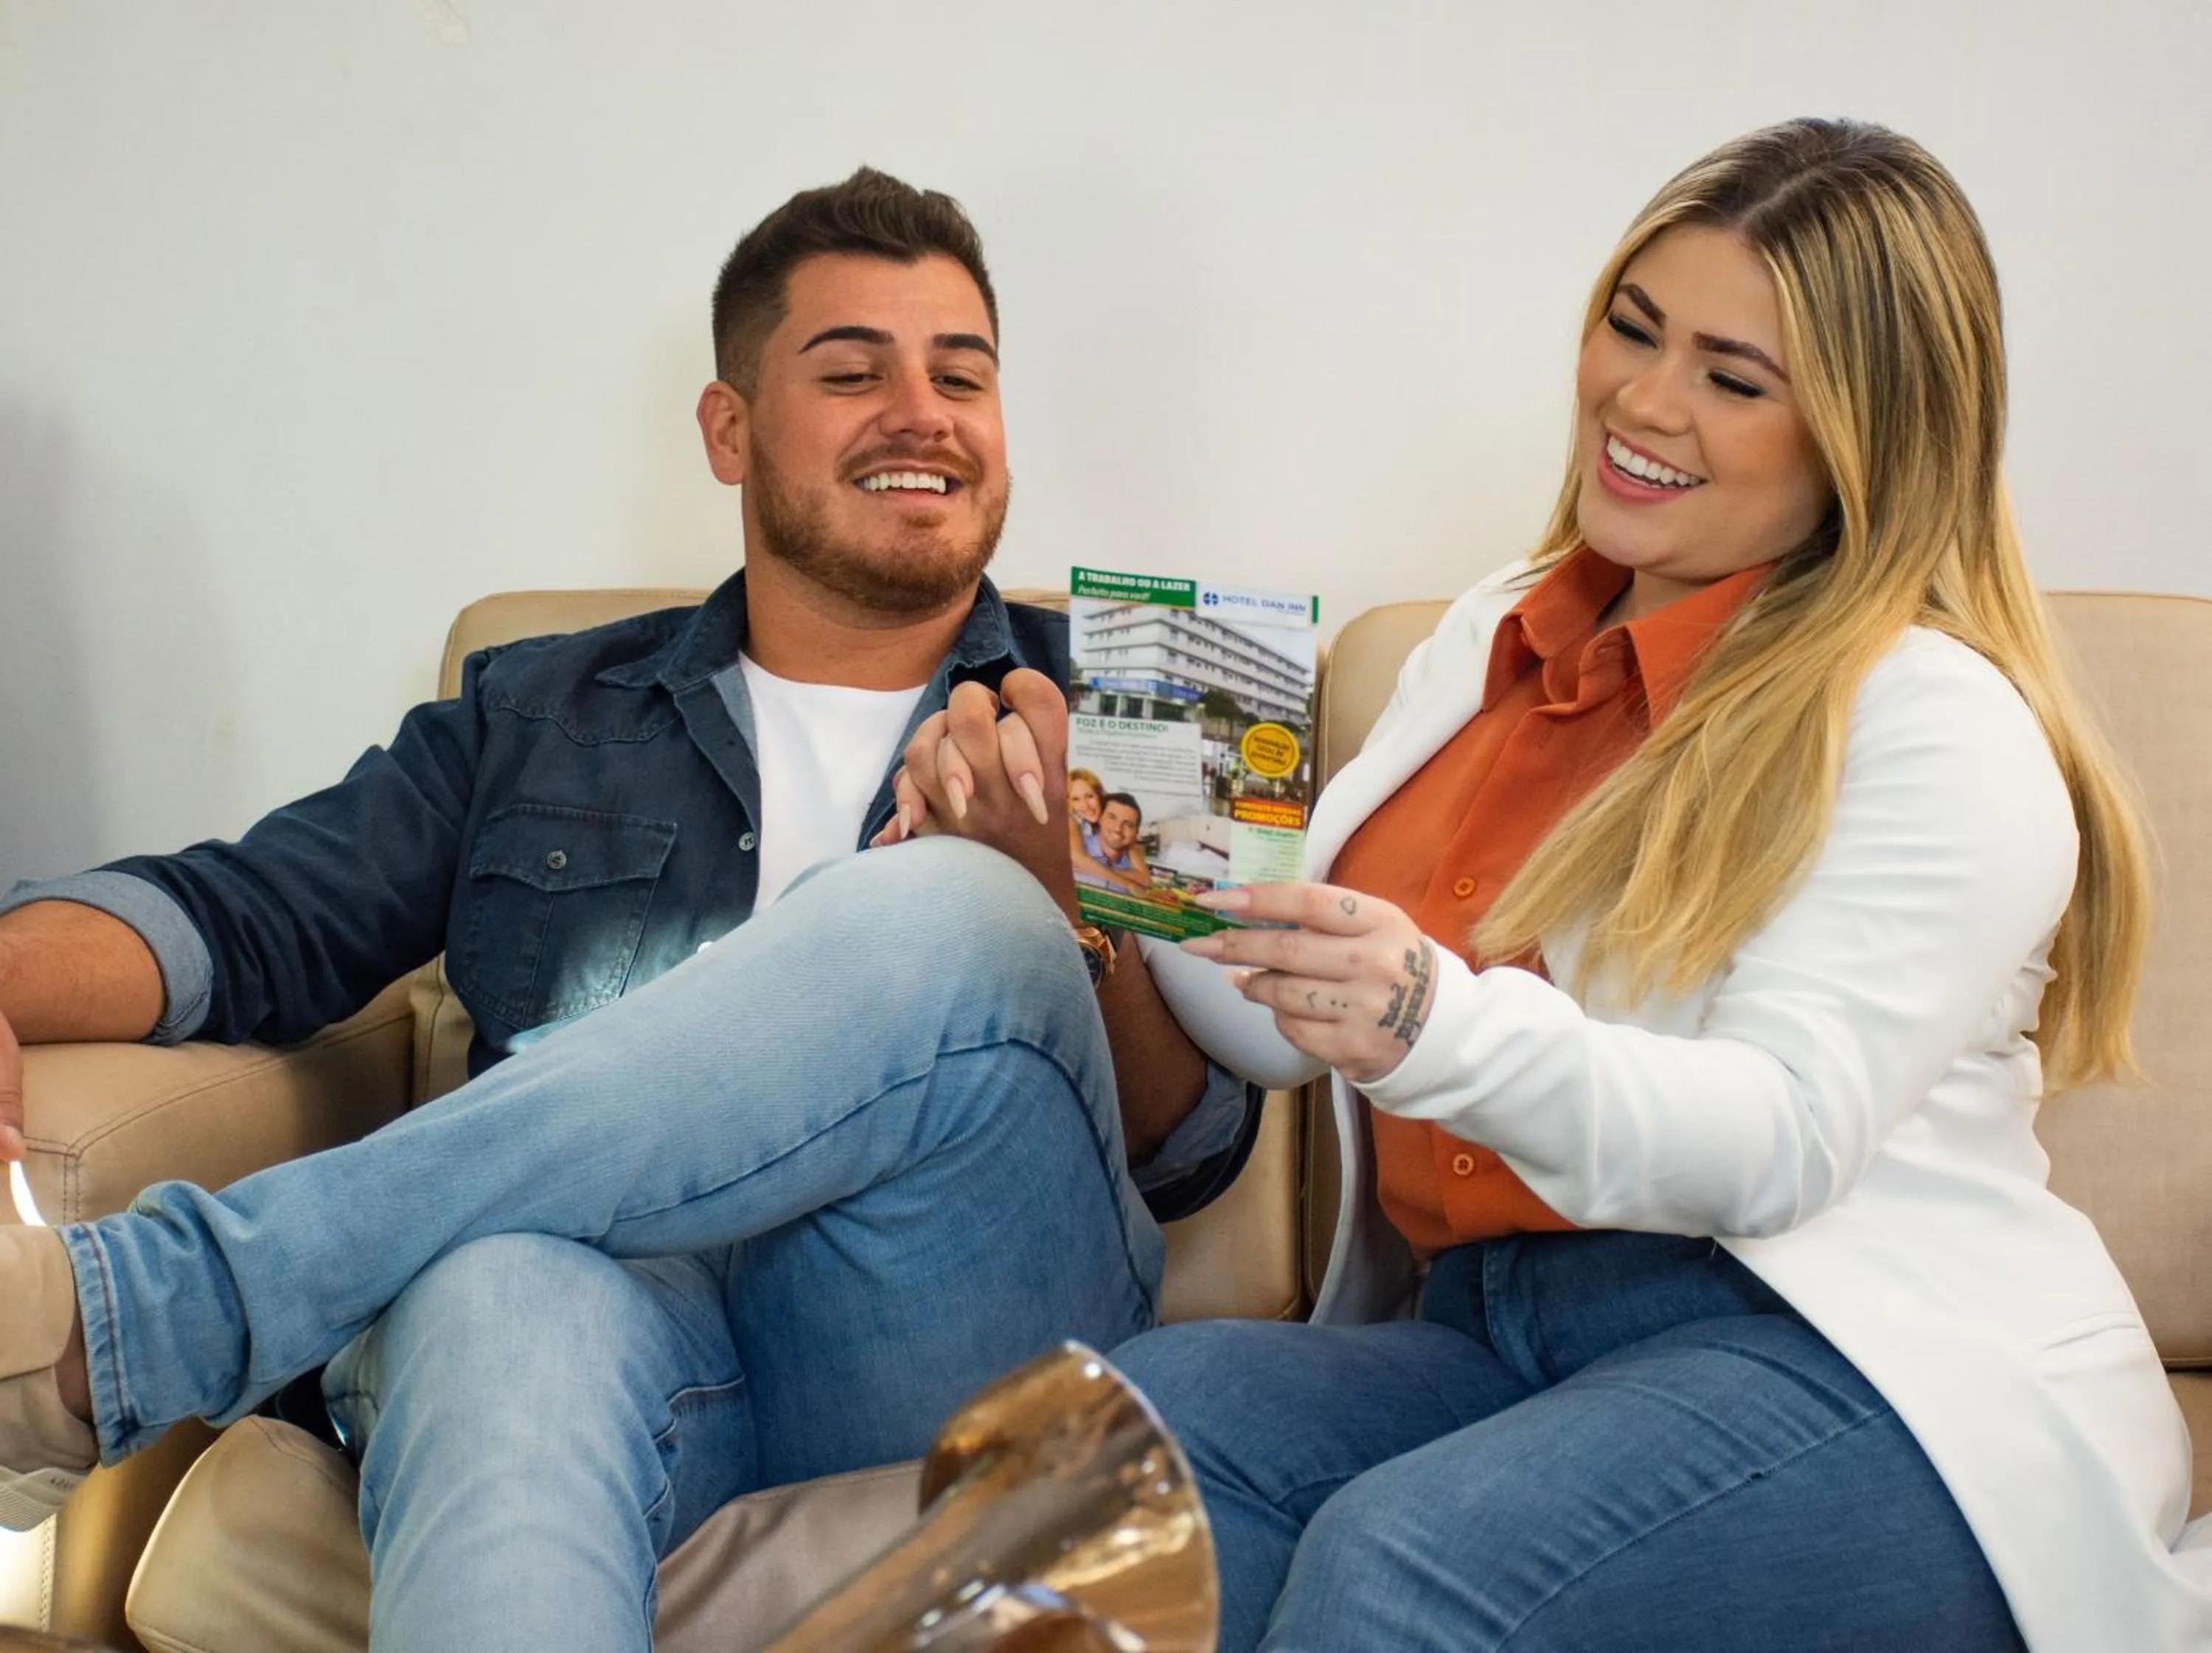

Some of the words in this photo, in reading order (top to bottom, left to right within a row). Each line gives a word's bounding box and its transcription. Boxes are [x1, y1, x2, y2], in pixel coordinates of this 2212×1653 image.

[1079, 571, 1085, 581] A
[1222, 594, 1257, 607] HOTEL
[1262, 599, 1285, 610] DAN
[1076, 717, 1096, 728] FOZ
[1108, 720, 1116, 729] O
[1234, 809, 1301, 826] PROMOÇÕES
